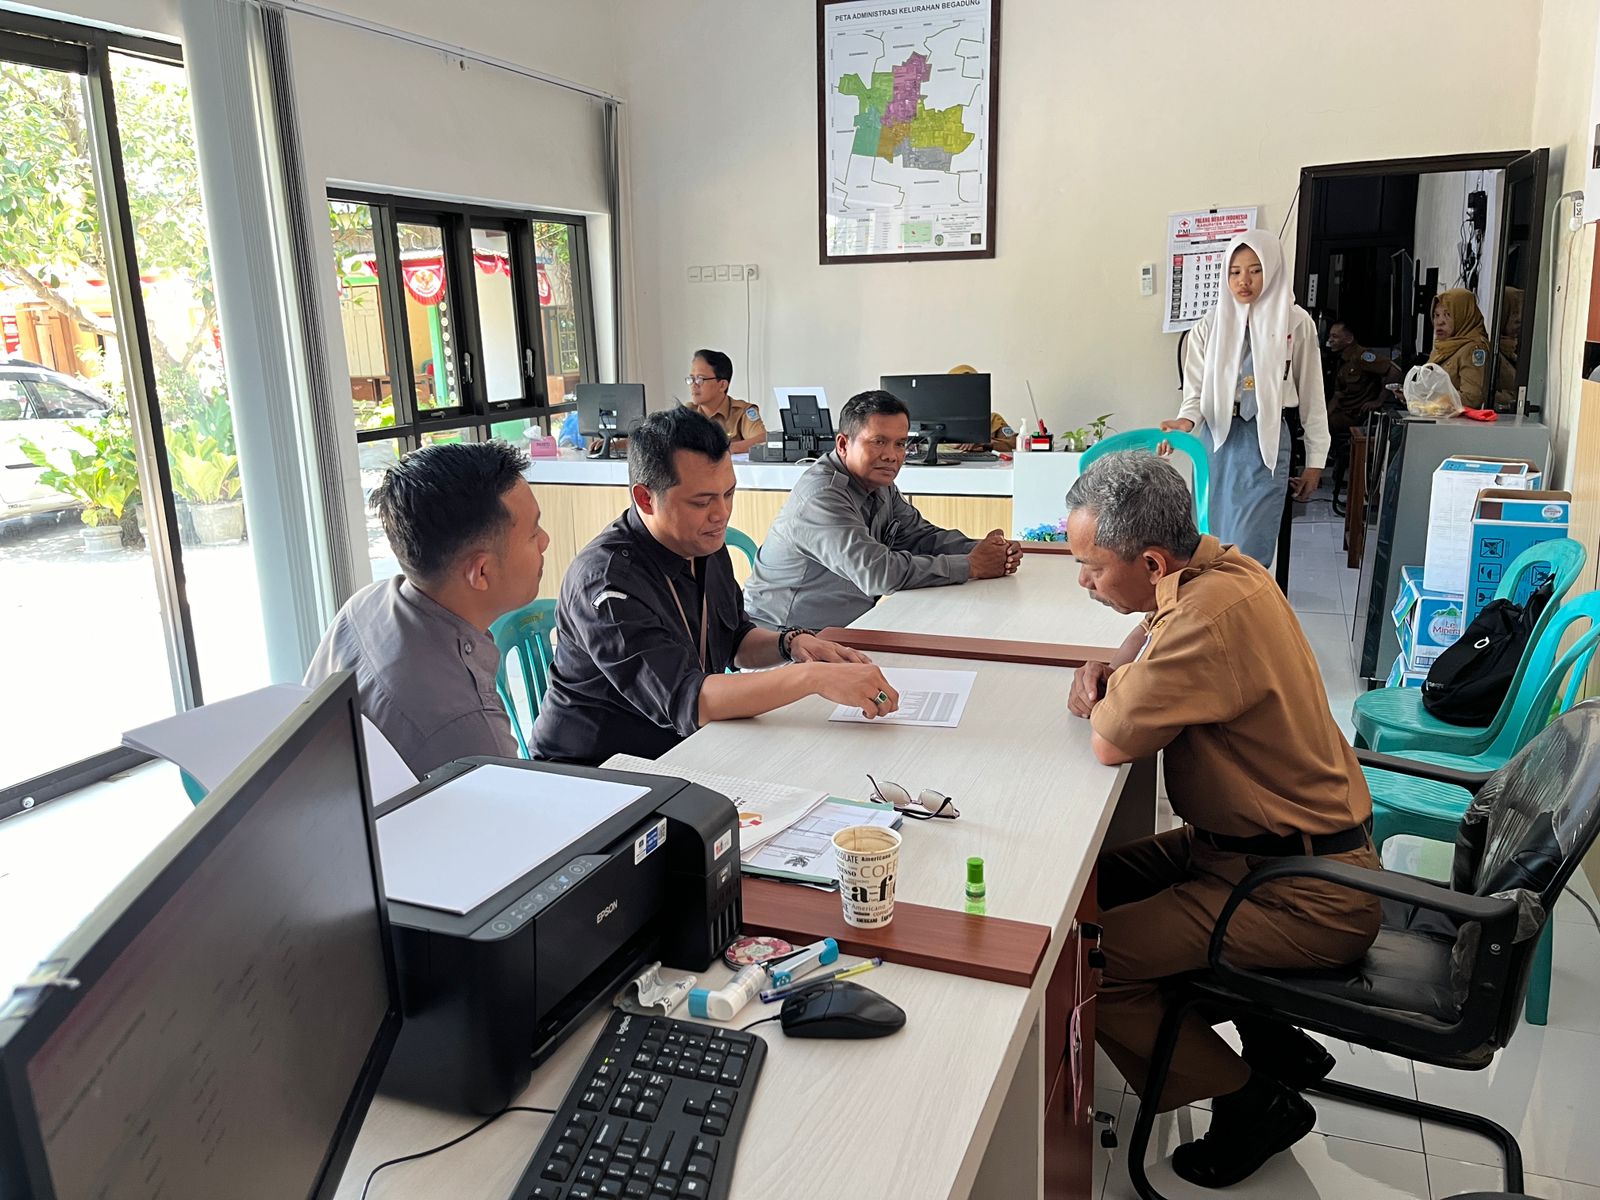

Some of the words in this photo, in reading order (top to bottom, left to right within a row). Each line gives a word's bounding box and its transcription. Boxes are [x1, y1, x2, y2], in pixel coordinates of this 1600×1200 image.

[834, 14, 851, 22] PETA
[852, 9, 898, 20] ADMINISTRASI
[899, 4, 940, 14] KELURAHAN
[941, 0, 981, 9] BEGADUNG
[1445, 620, 1456, 629] Le
[596, 899, 618, 924] EPSON
[615, 1015, 632, 1035] logitech
